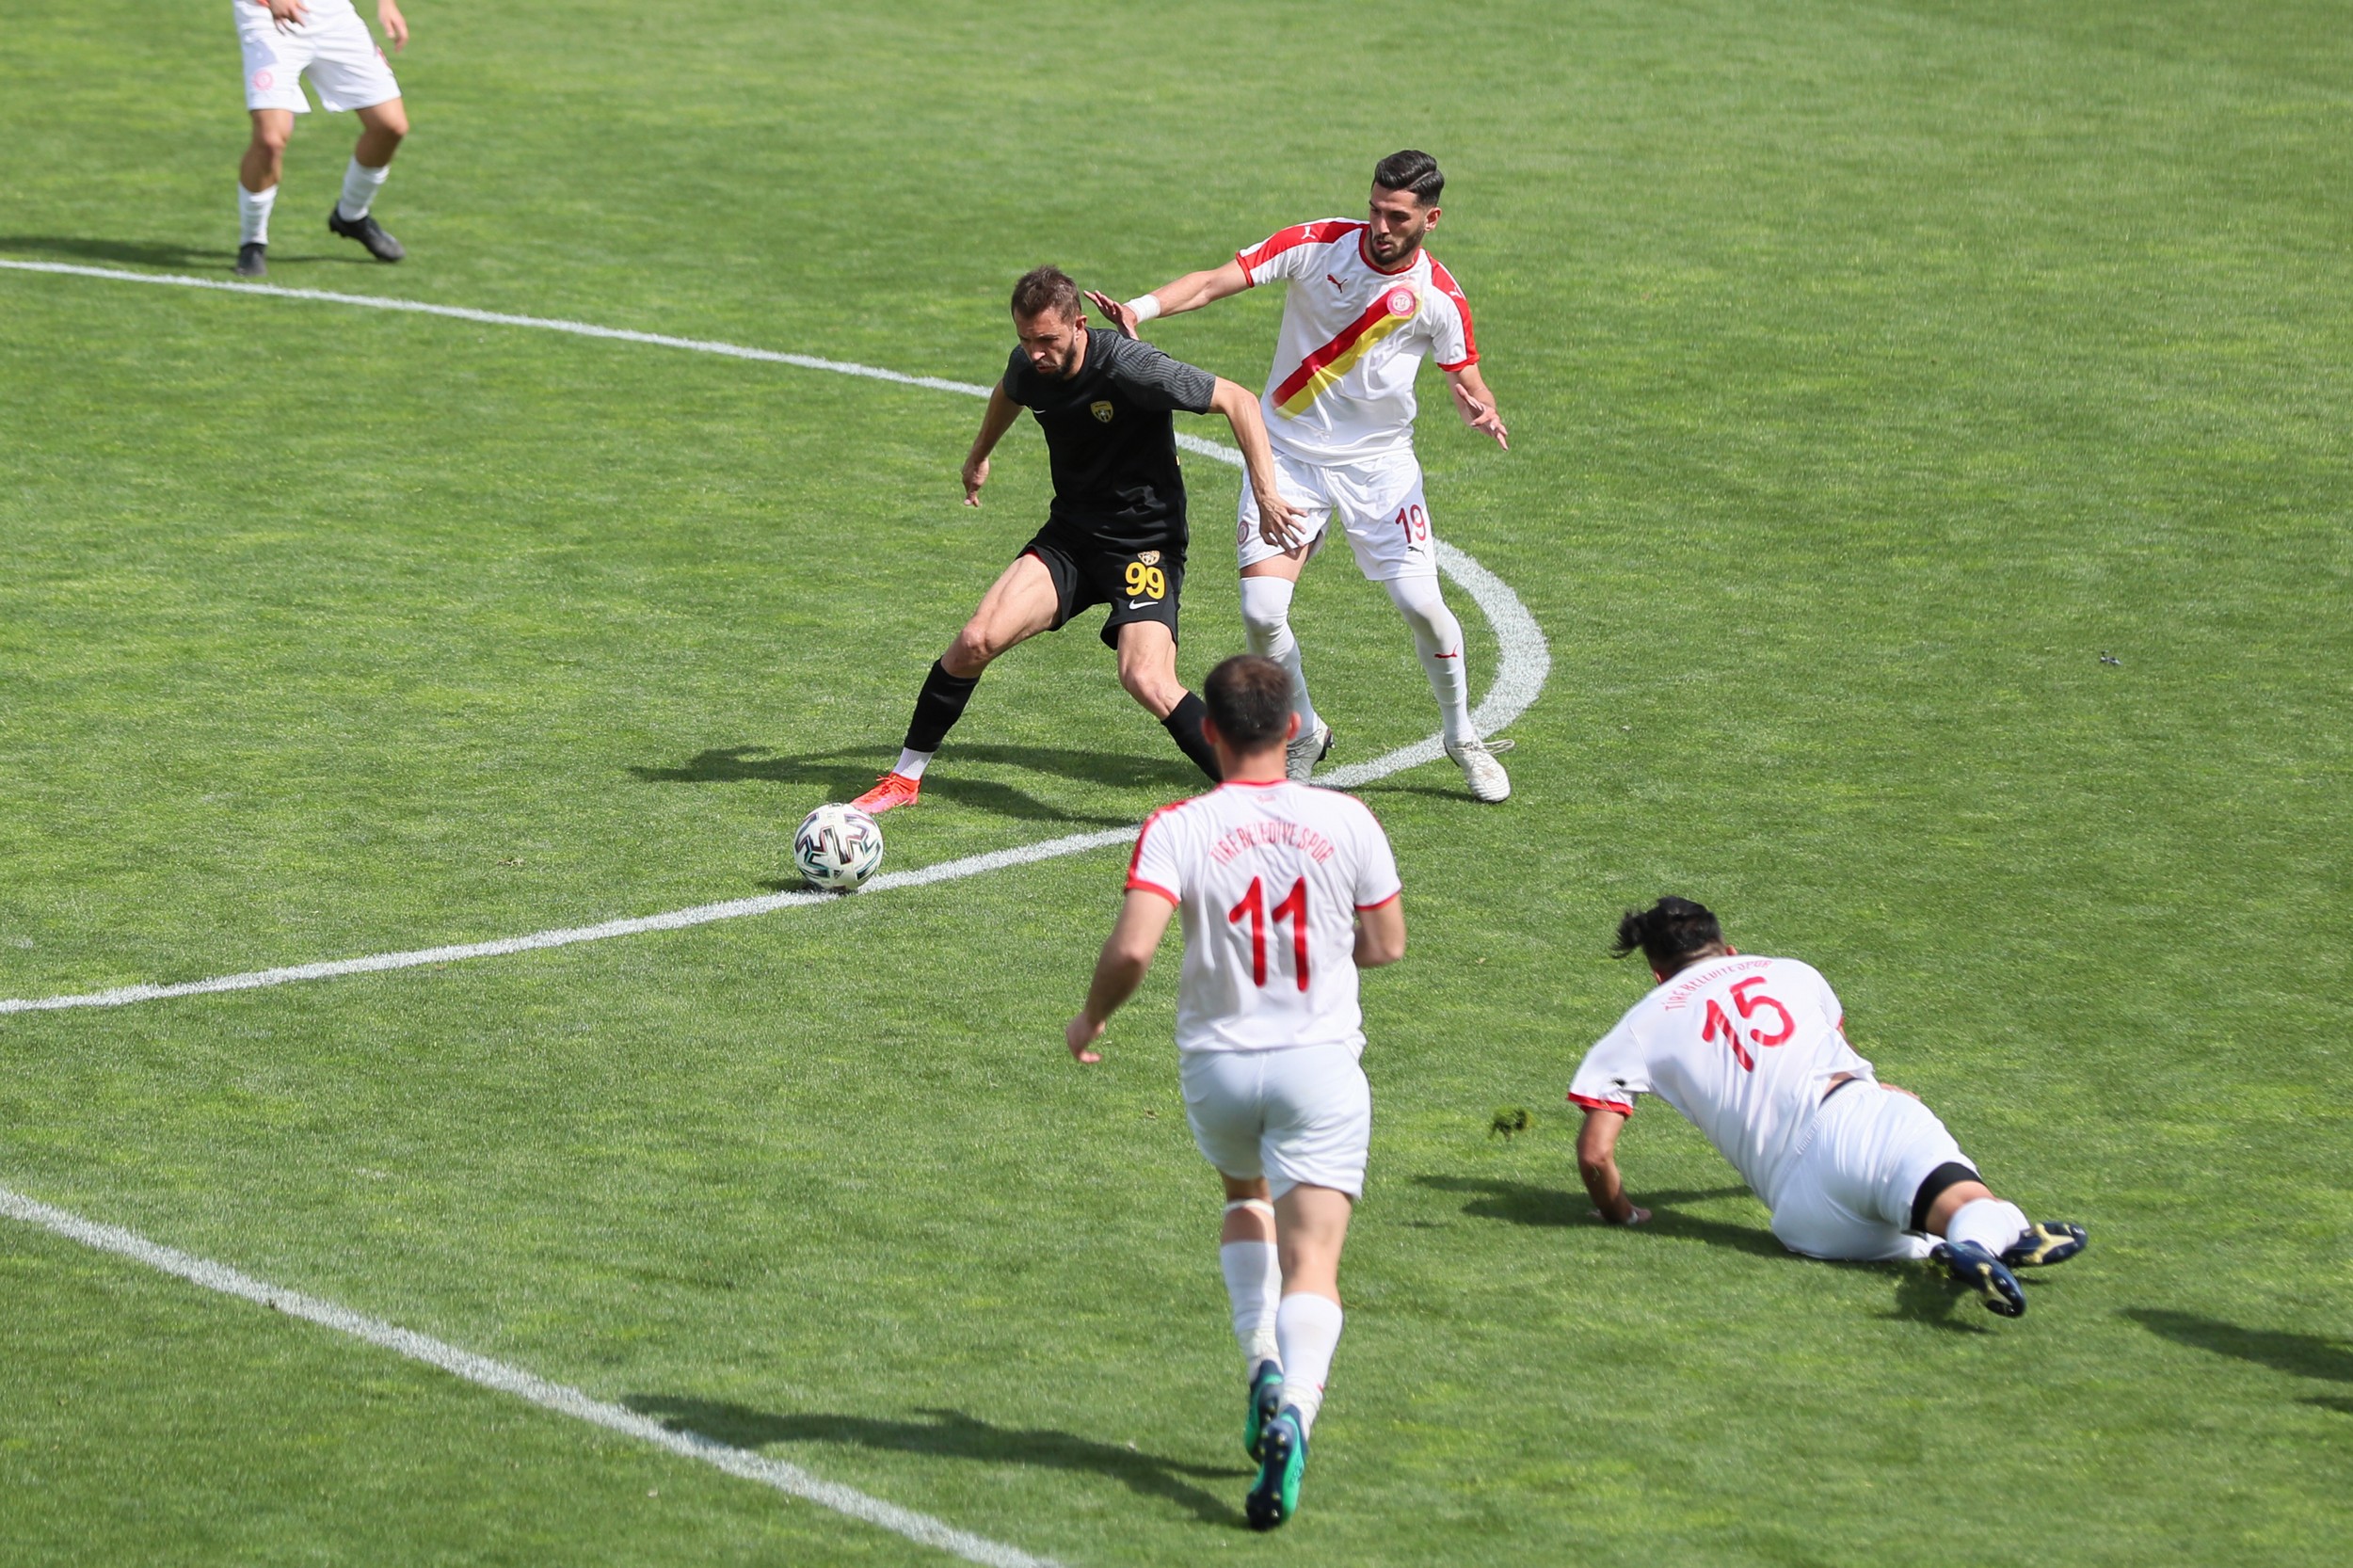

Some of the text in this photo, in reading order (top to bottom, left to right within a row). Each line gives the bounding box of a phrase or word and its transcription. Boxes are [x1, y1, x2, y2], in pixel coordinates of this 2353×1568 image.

[1395, 504, 1426, 543] 19
[1125, 562, 1166, 600] 99
[1297, 828, 1334, 864] SPOR
[1227, 875, 1310, 993] 11
[1702, 976, 1796, 1073] 15
